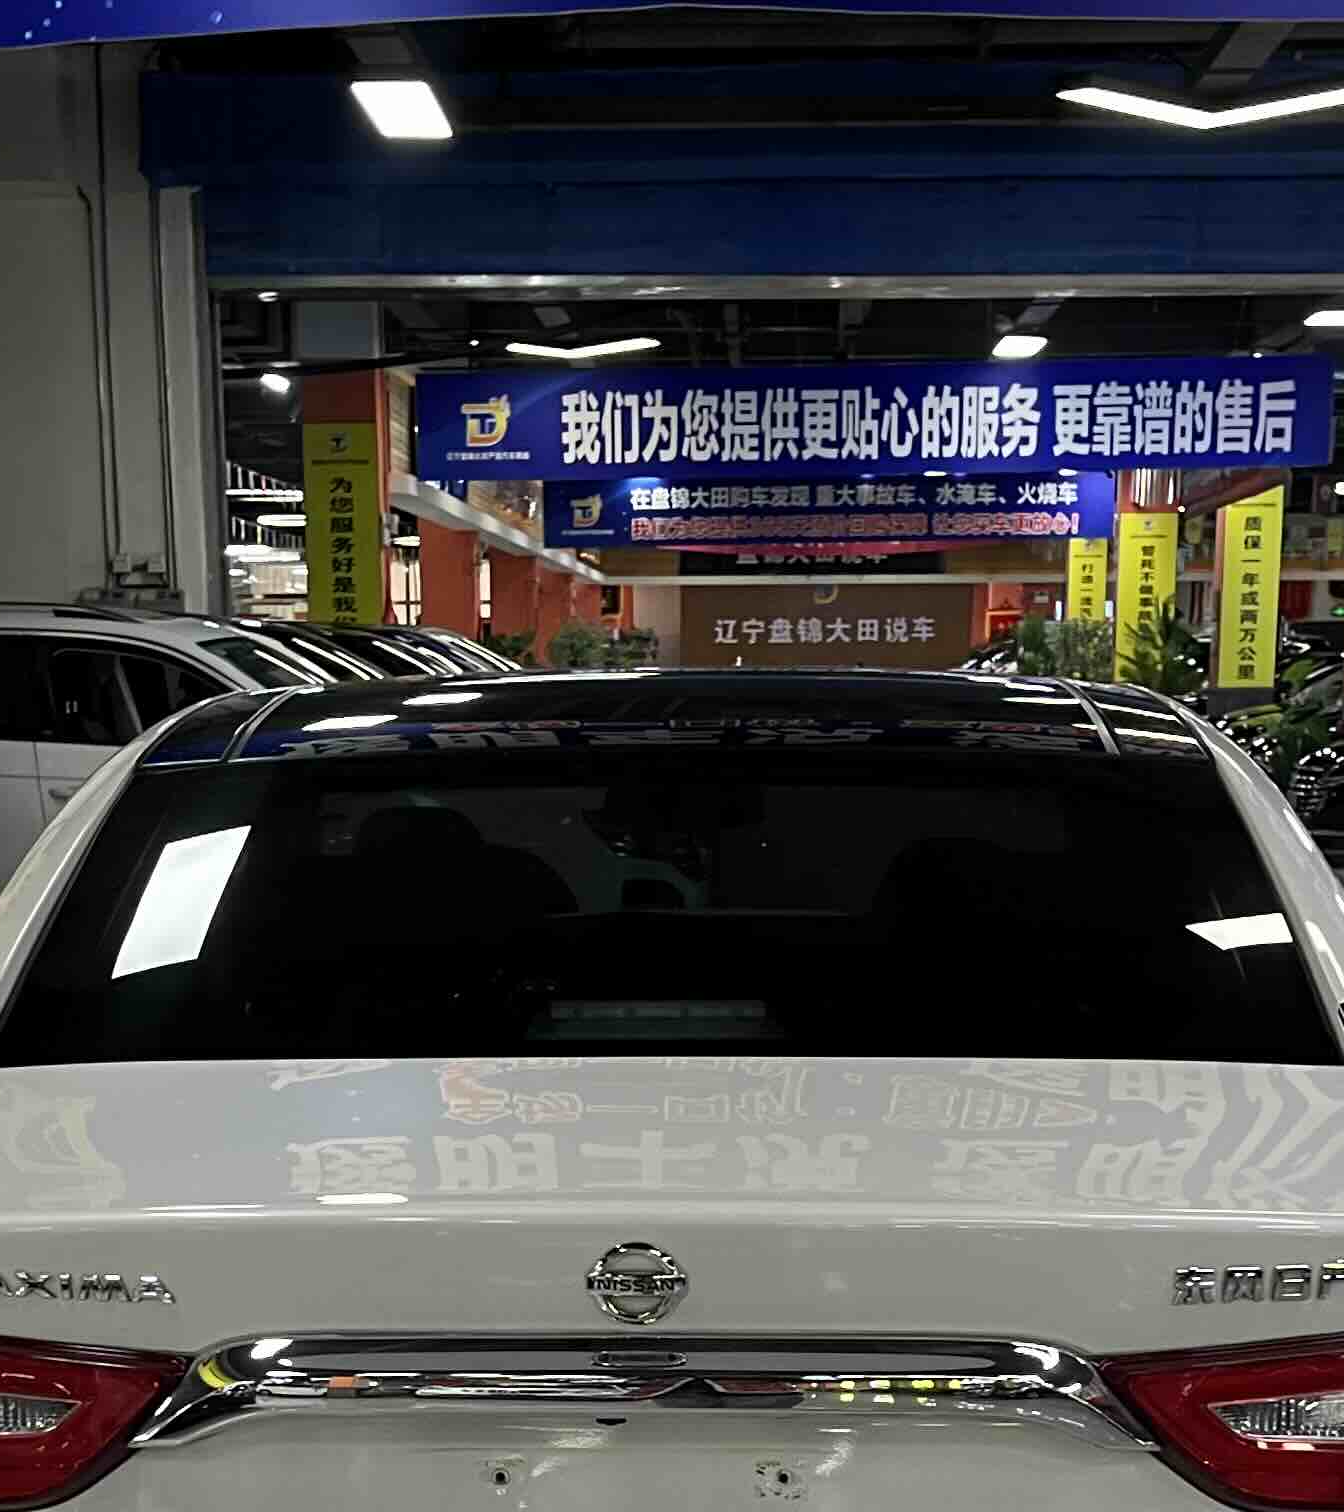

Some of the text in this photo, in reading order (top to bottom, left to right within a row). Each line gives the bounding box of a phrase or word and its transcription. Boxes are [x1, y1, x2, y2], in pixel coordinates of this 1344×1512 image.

[561, 378, 1297, 464] 我们为您提供更贴心的服务 更靠谱的售后
[1236, 515, 1264, 681] 质保一年或两万公里
[714, 616, 936, 645] 辽宁盘锦大田说车
[596, 1278, 675, 1294] NISSAN
